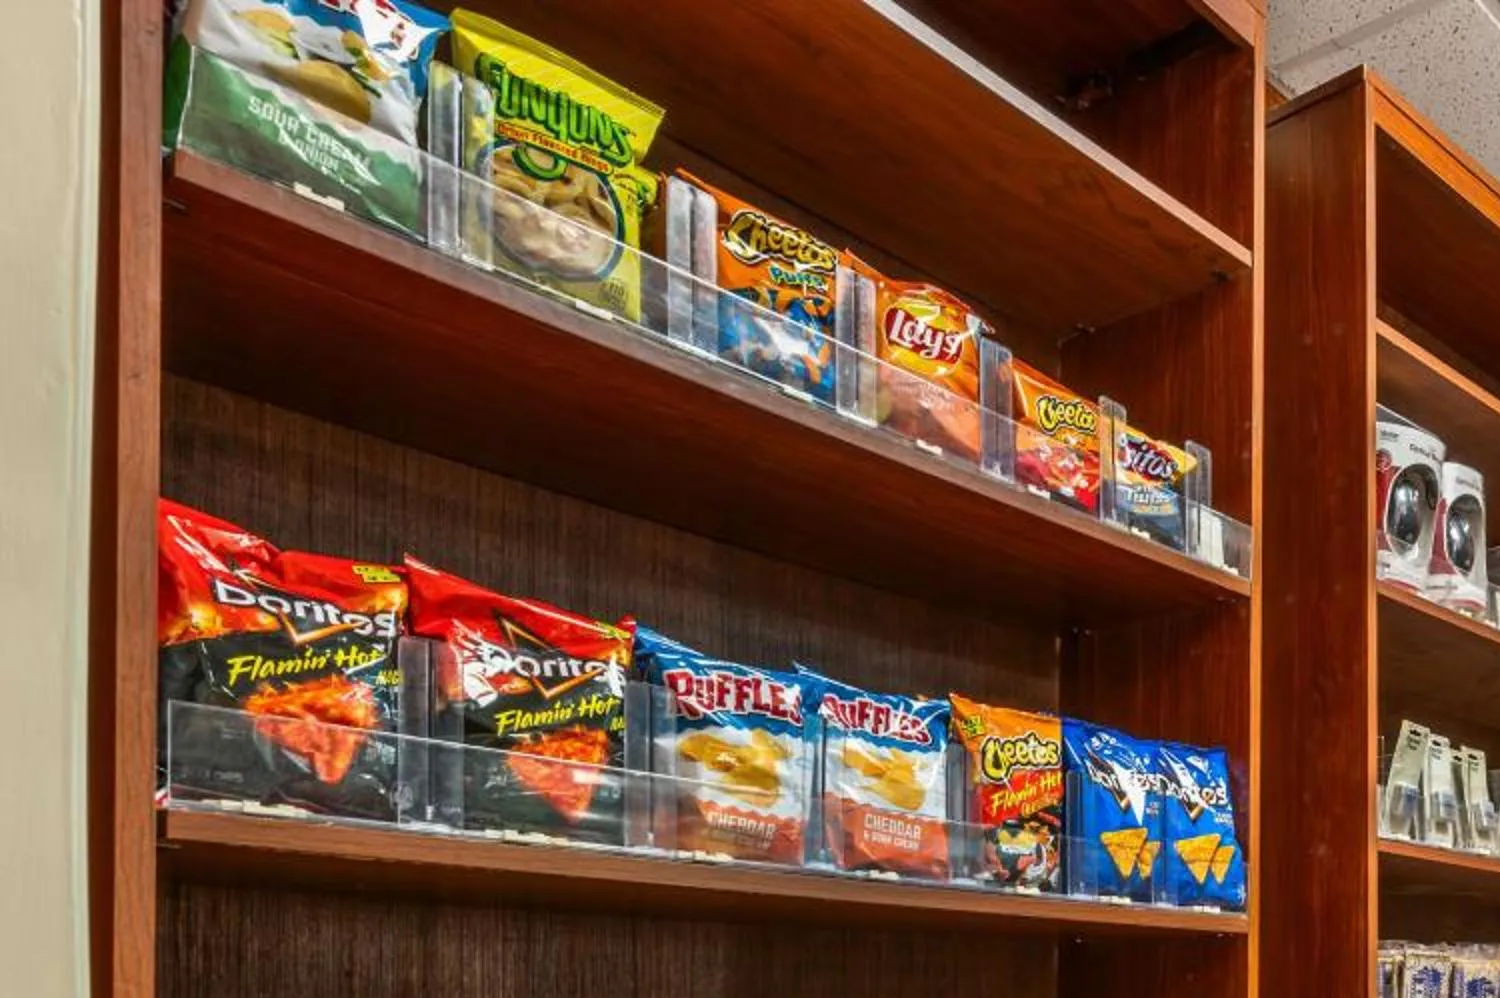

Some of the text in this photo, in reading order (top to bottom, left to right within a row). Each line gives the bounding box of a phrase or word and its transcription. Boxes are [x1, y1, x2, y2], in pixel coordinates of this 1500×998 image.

[248, 95, 301, 136] SOUR
[723, 210, 837, 271] Cheetos
[213, 578, 397, 638] Doritos
[226, 645, 386, 687] Flamin' Hot
[494, 695, 621, 735] Flamin' Hot
[819, 693, 933, 746] RUFFLES
[981, 737, 1061, 781] Cheetos
[863, 812, 922, 841] CHEDDAR
